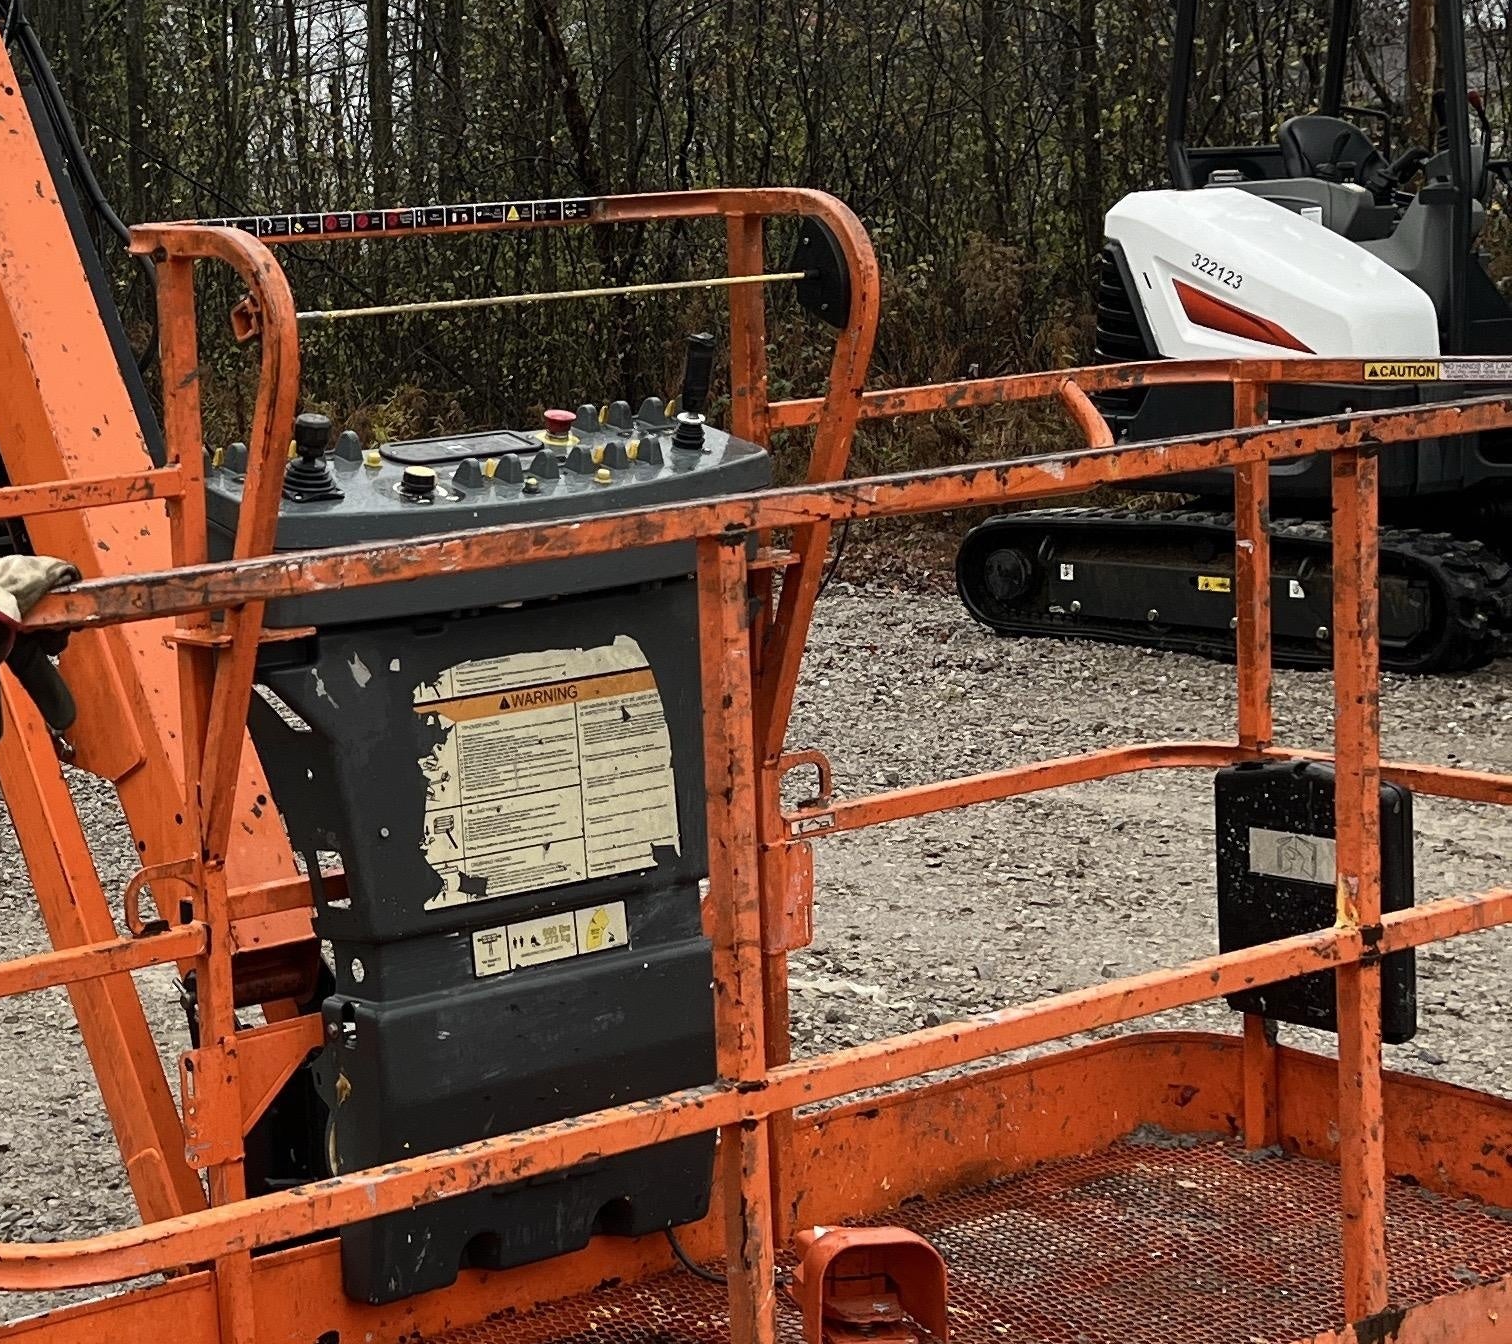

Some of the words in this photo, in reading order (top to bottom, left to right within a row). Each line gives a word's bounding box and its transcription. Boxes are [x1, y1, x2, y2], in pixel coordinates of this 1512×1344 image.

[1191, 253, 1243, 289] 322123
[1379, 365, 1435, 377] CAUTION
[510, 684, 578, 708] WARNING
